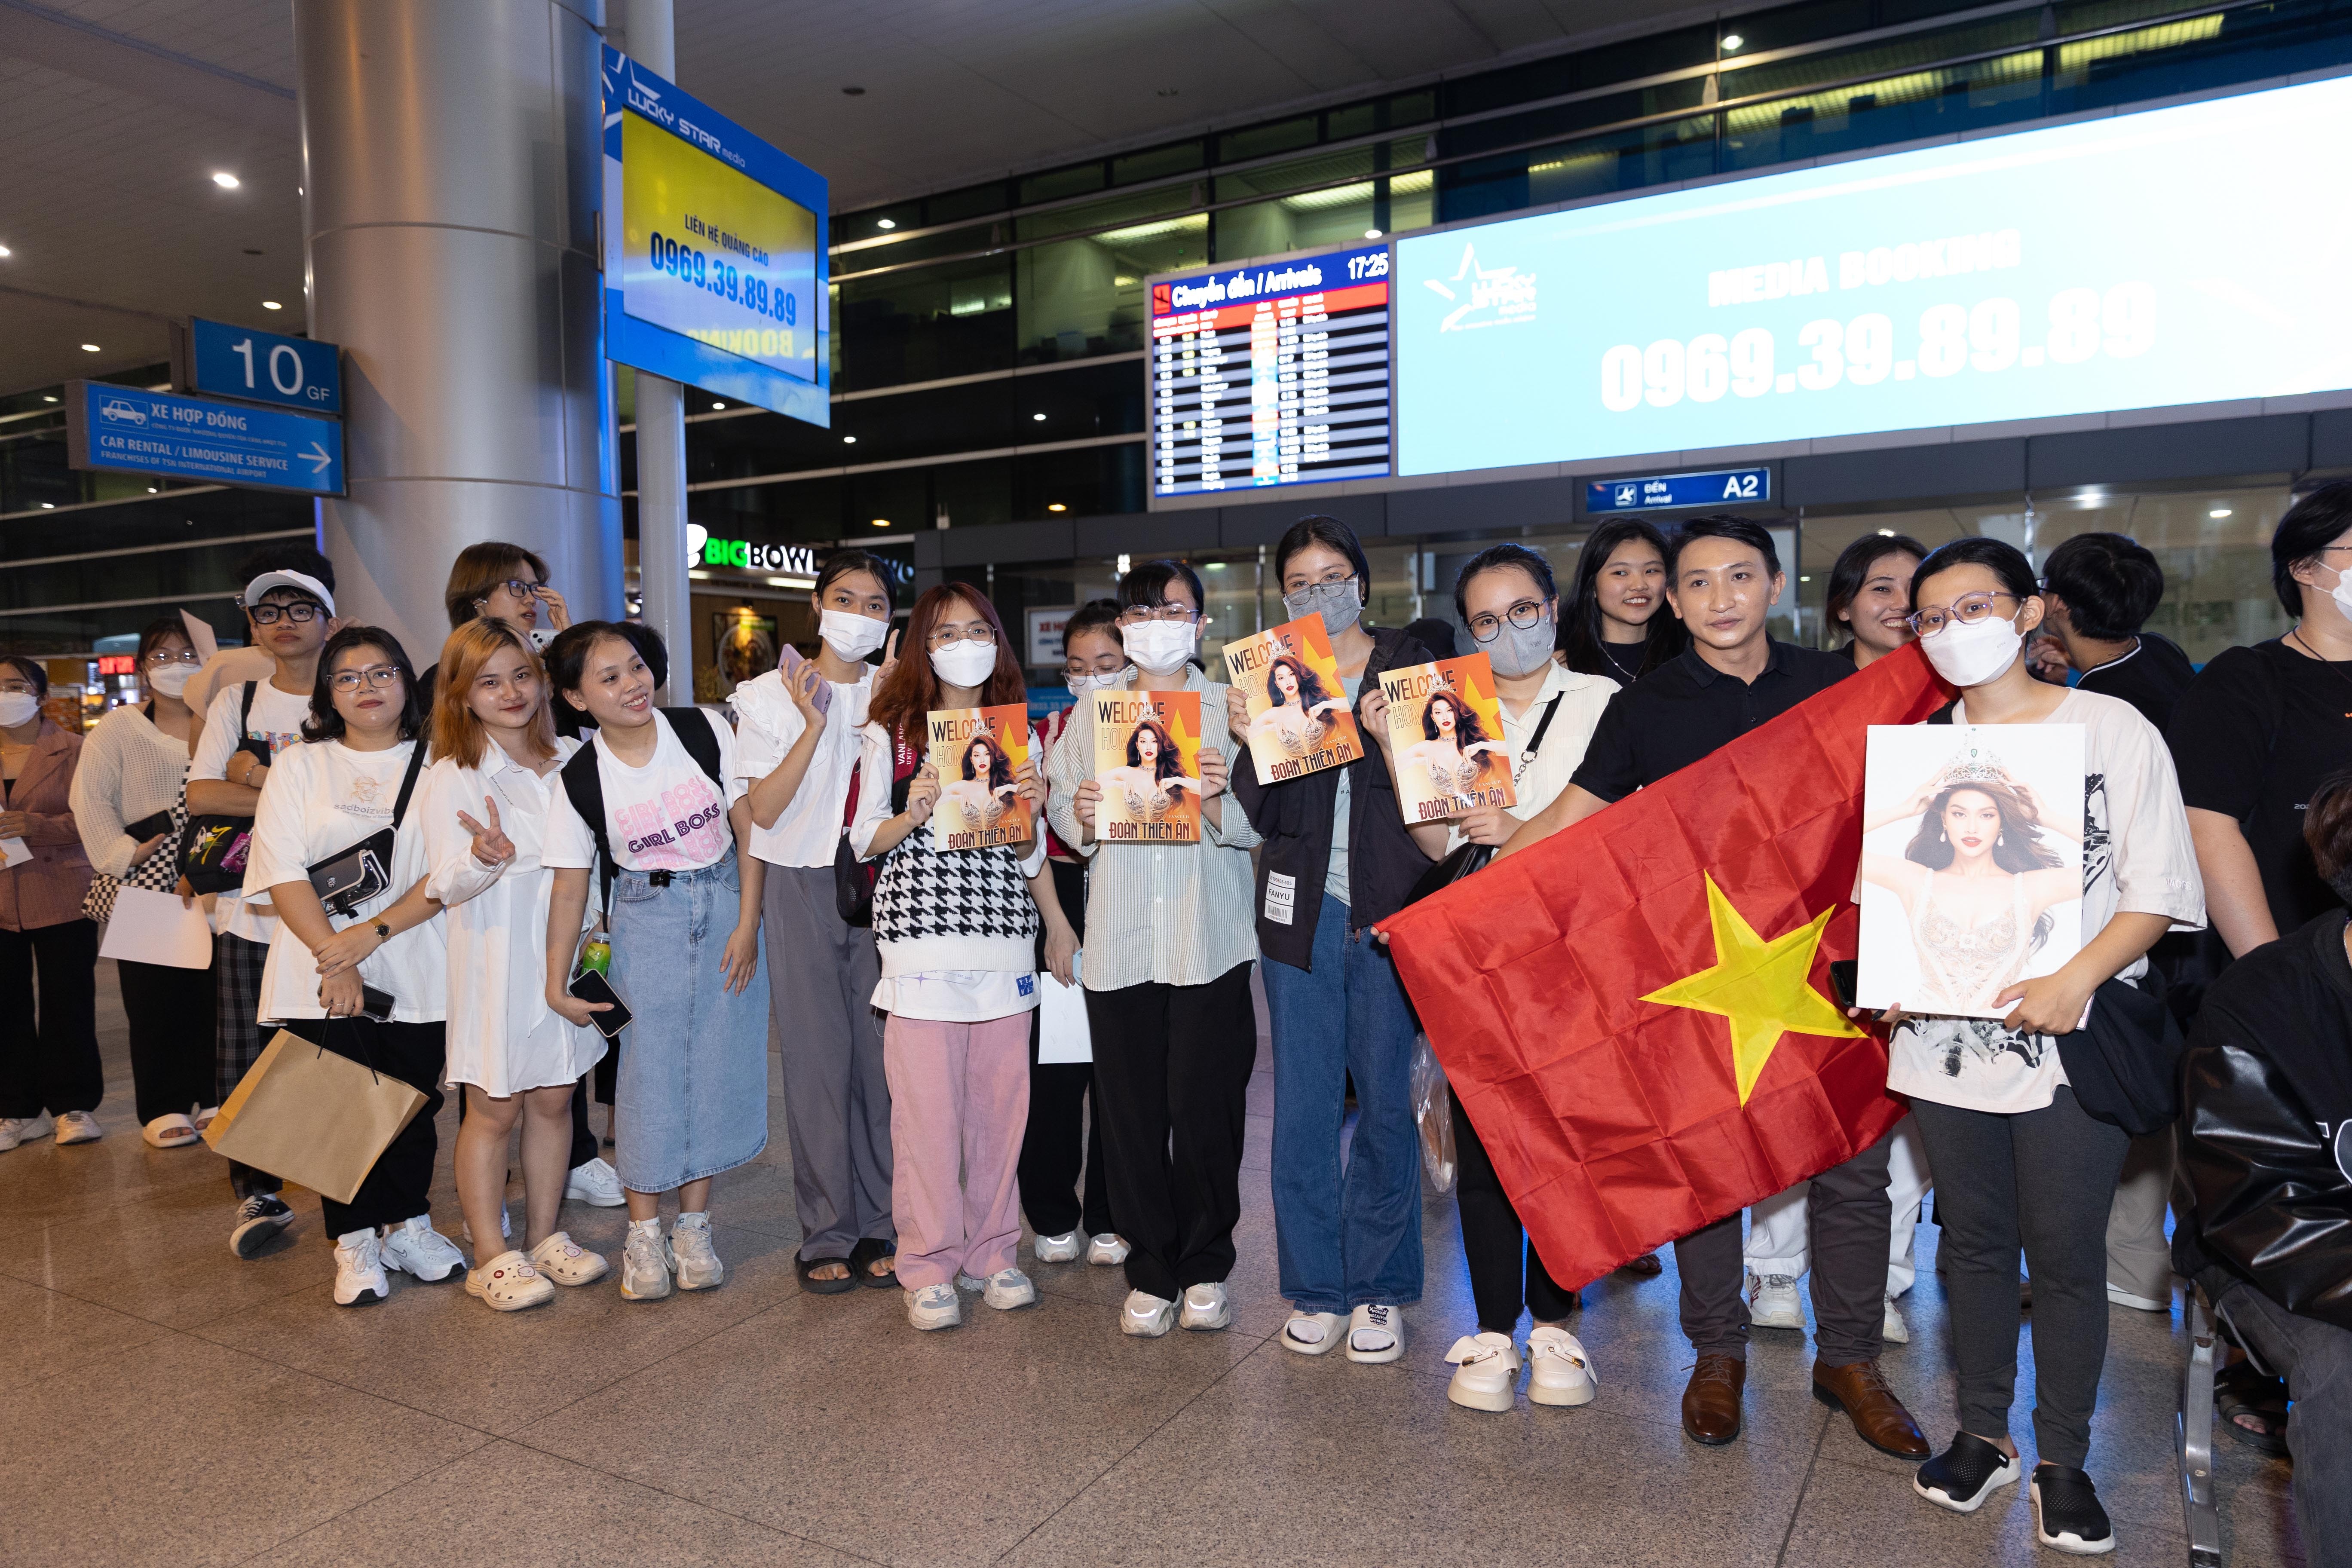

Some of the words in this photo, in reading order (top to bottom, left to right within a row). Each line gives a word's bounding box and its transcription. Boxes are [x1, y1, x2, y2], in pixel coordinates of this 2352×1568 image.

[627, 86, 674, 126] LUCKY
[679, 117, 721, 153] STAR
[722, 147, 746, 168] media
[684, 213, 705, 238] LIÊN
[707, 224, 720, 246] HỆ
[721, 232, 750, 258] QUẢNG
[650, 231, 796, 326] 0969.39.89.89
[1256, 273, 1264, 294] /
[1265, 264, 1322, 293] Arrivals
[1348, 252, 1389, 280] 17:25
[1709, 252, 1830, 307] MEDIA
[1839, 229, 2021, 291] BOOKING
[1601, 280, 2156, 412] 0969.39.89.89
[232, 338, 304, 395] 10
[306, 386, 330, 401] GF
[150, 402, 169, 420] XE
[172, 406, 203, 426] HỢP
[100, 435, 125, 449] CAR
[129, 438, 172, 456] RENTAL
[182, 447, 244, 465] LIMOUSINE
[245, 455, 288, 471] SERVICE
[150, 457, 160, 465] OF
[1644, 480, 1667, 493] ĐẾN
[1722, 475, 1759, 499] A2
[1644, 493, 1672, 505] Arrival
[1239, 669, 1271, 699] HOM
[1393, 702, 1427, 729] HOM
[1271, 758, 1302, 781] ĐOÀN
[1304, 748, 1335, 772] THIÊN
[1336, 742, 1353, 762] ÂN
[1418, 796, 1451, 820] ĐOÀN
[1488, 786, 1505, 807] ÂN
[628, 829, 676, 853] GIRL
[674, 803, 720, 837] BOSS
[948, 829, 975, 849] ĐOÀN
[978, 823, 1007, 846] THIÊN
[1009, 821, 1022, 841] ÂN
[1109, 818, 1138, 839] ĐOÀN
[1142, 819, 1172, 839] THIÊN
[1176, 820, 1189, 839] ÂN
[1268, 888, 1290, 900] FANYU
